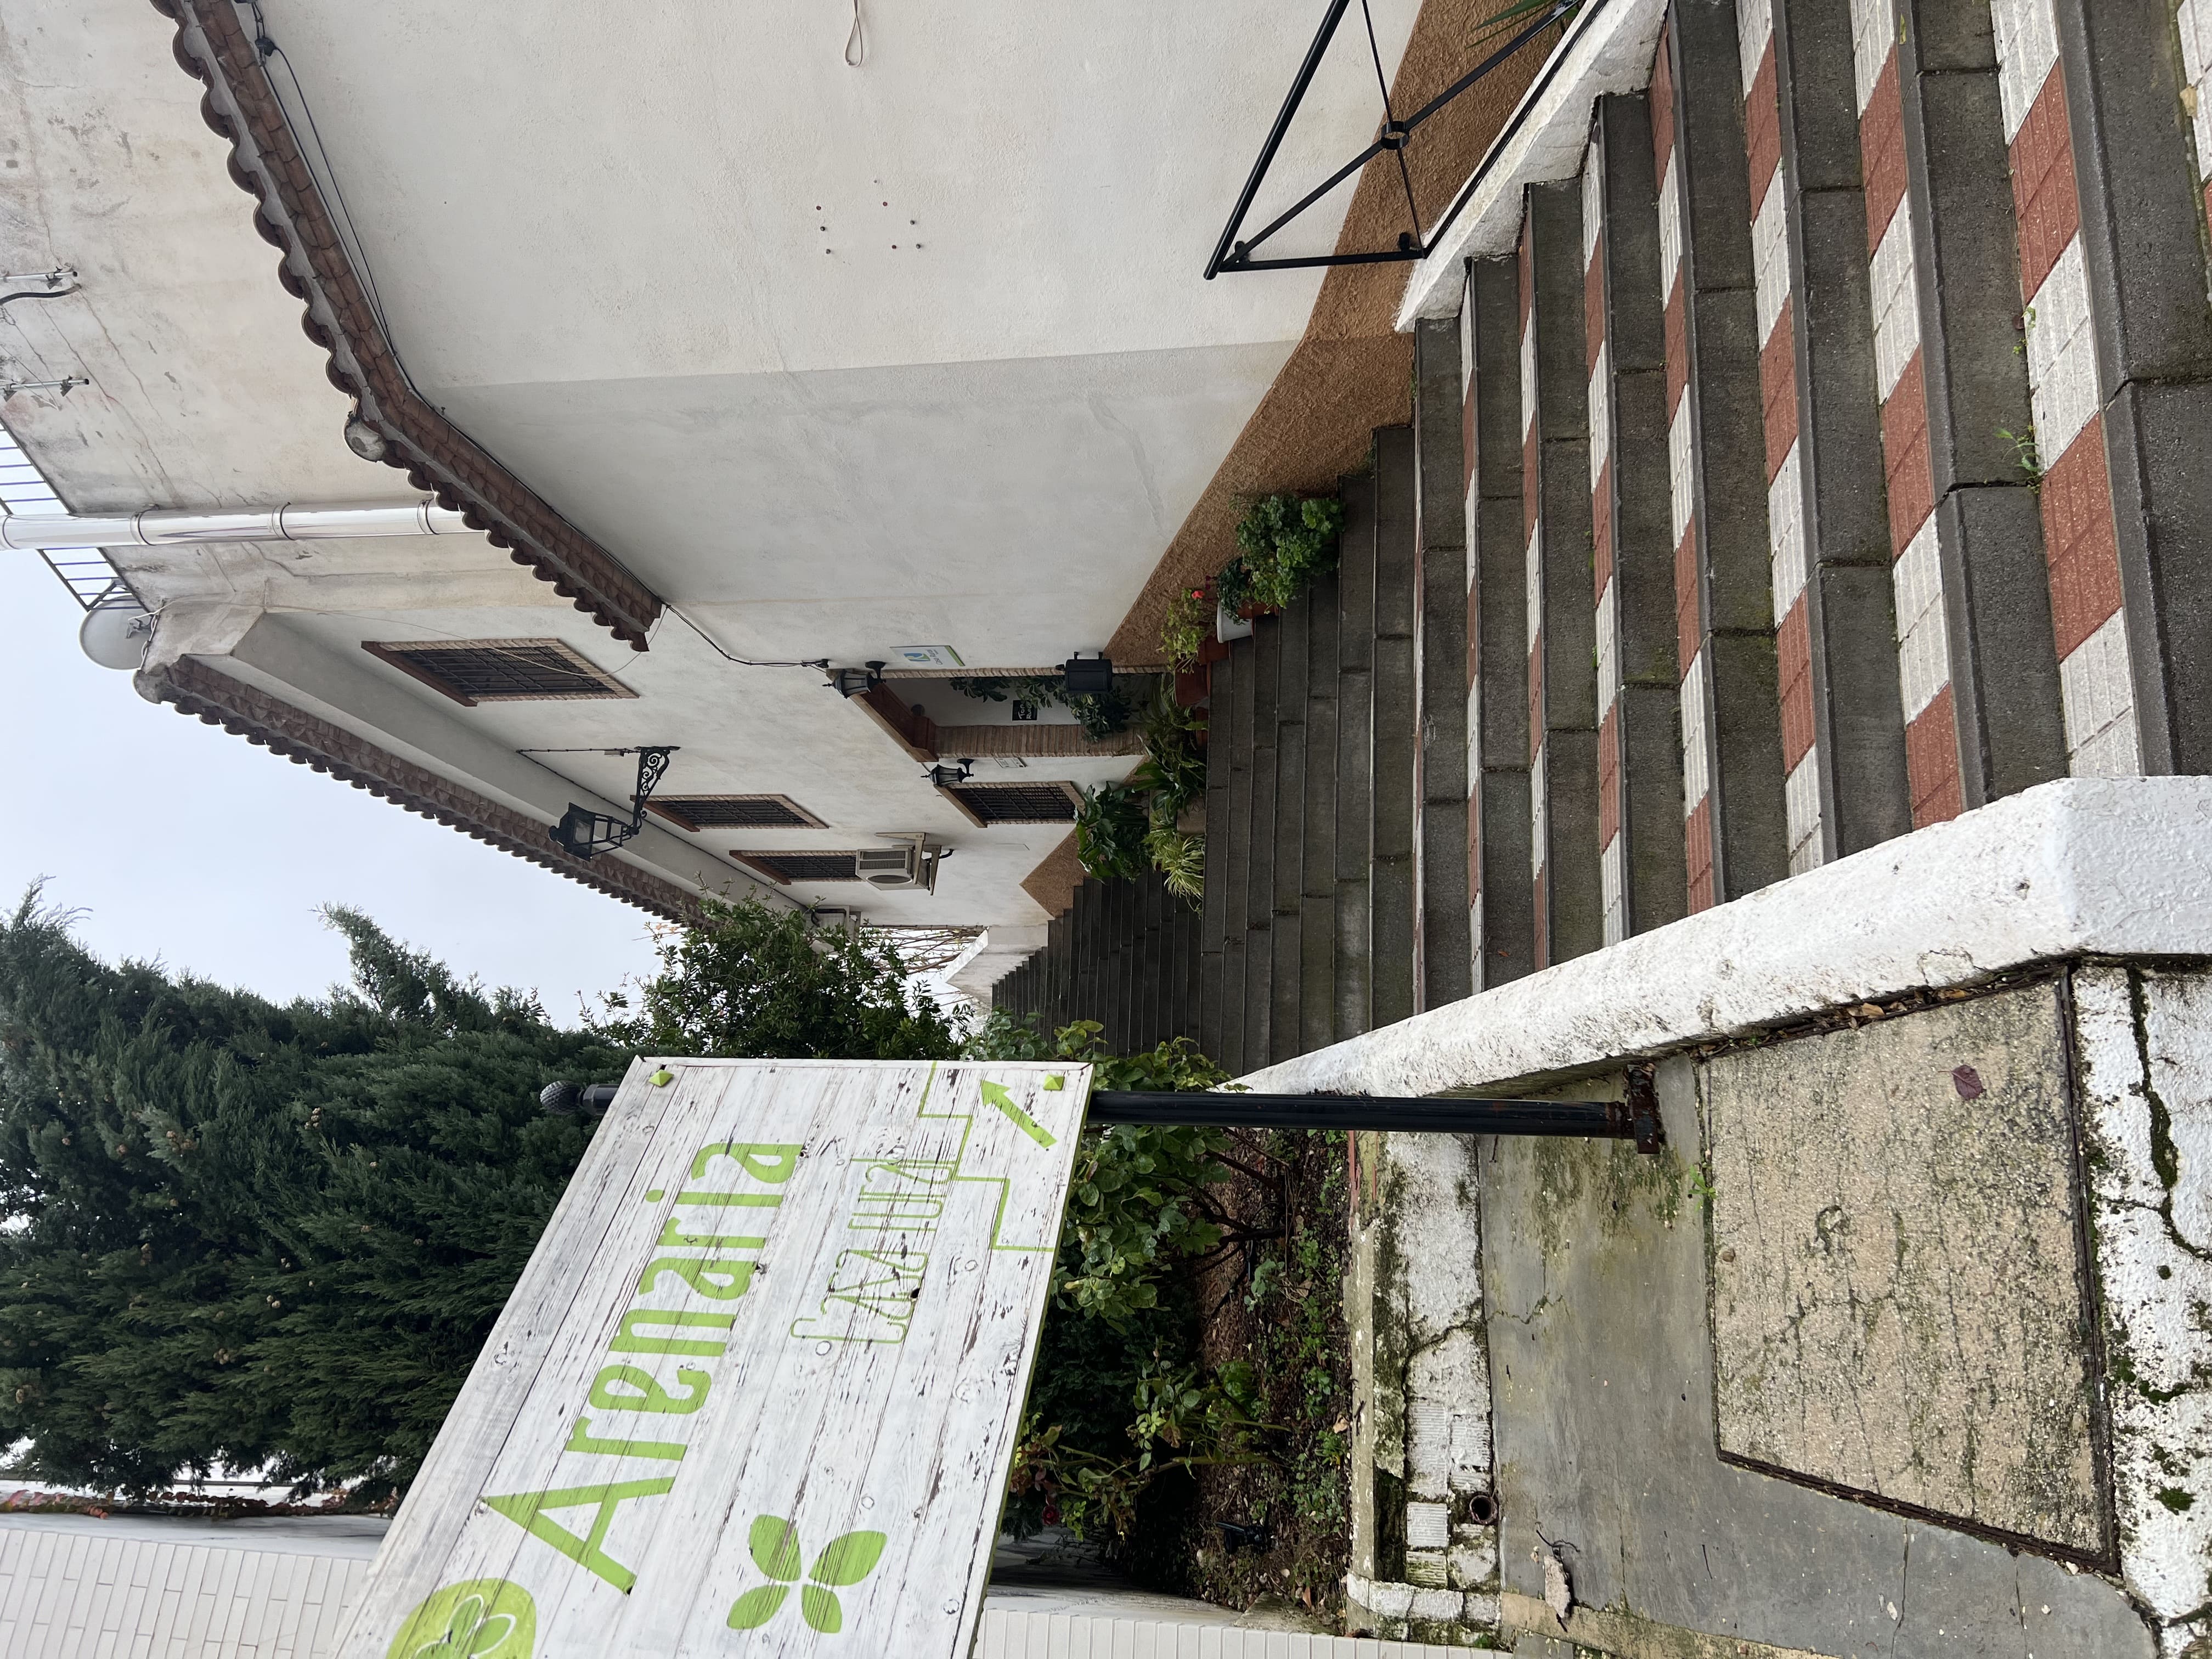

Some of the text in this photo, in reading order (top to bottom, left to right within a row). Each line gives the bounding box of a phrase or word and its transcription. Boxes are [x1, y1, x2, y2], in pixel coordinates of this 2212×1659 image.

[481, 1142, 802, 1594] Arenaria
[789, 1156, 958, 1345] Casa rural
